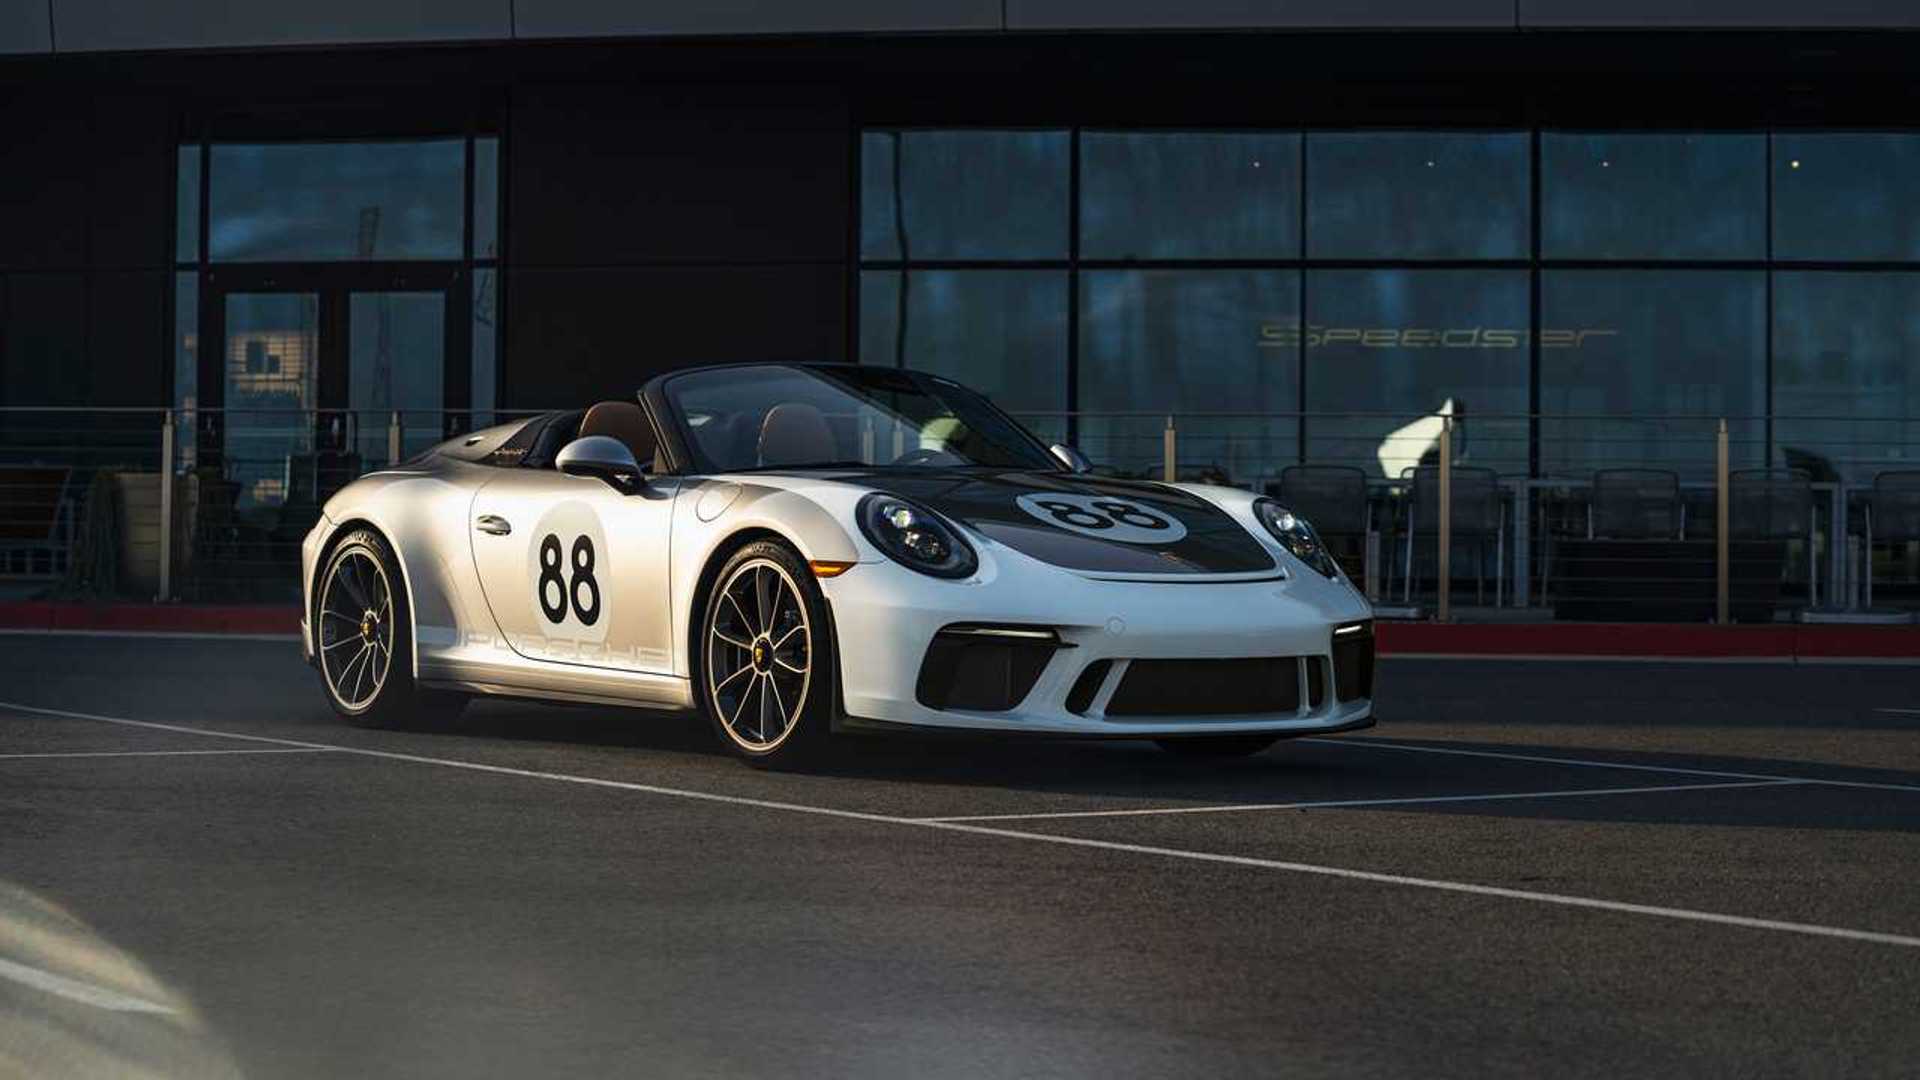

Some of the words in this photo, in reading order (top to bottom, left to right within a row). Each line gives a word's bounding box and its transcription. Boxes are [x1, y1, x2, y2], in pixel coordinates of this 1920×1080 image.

[1257, 324, 1618, 348] Speedser
[1035, 501, 1170, 530] 88
[538, 534, 601, 626] 88
